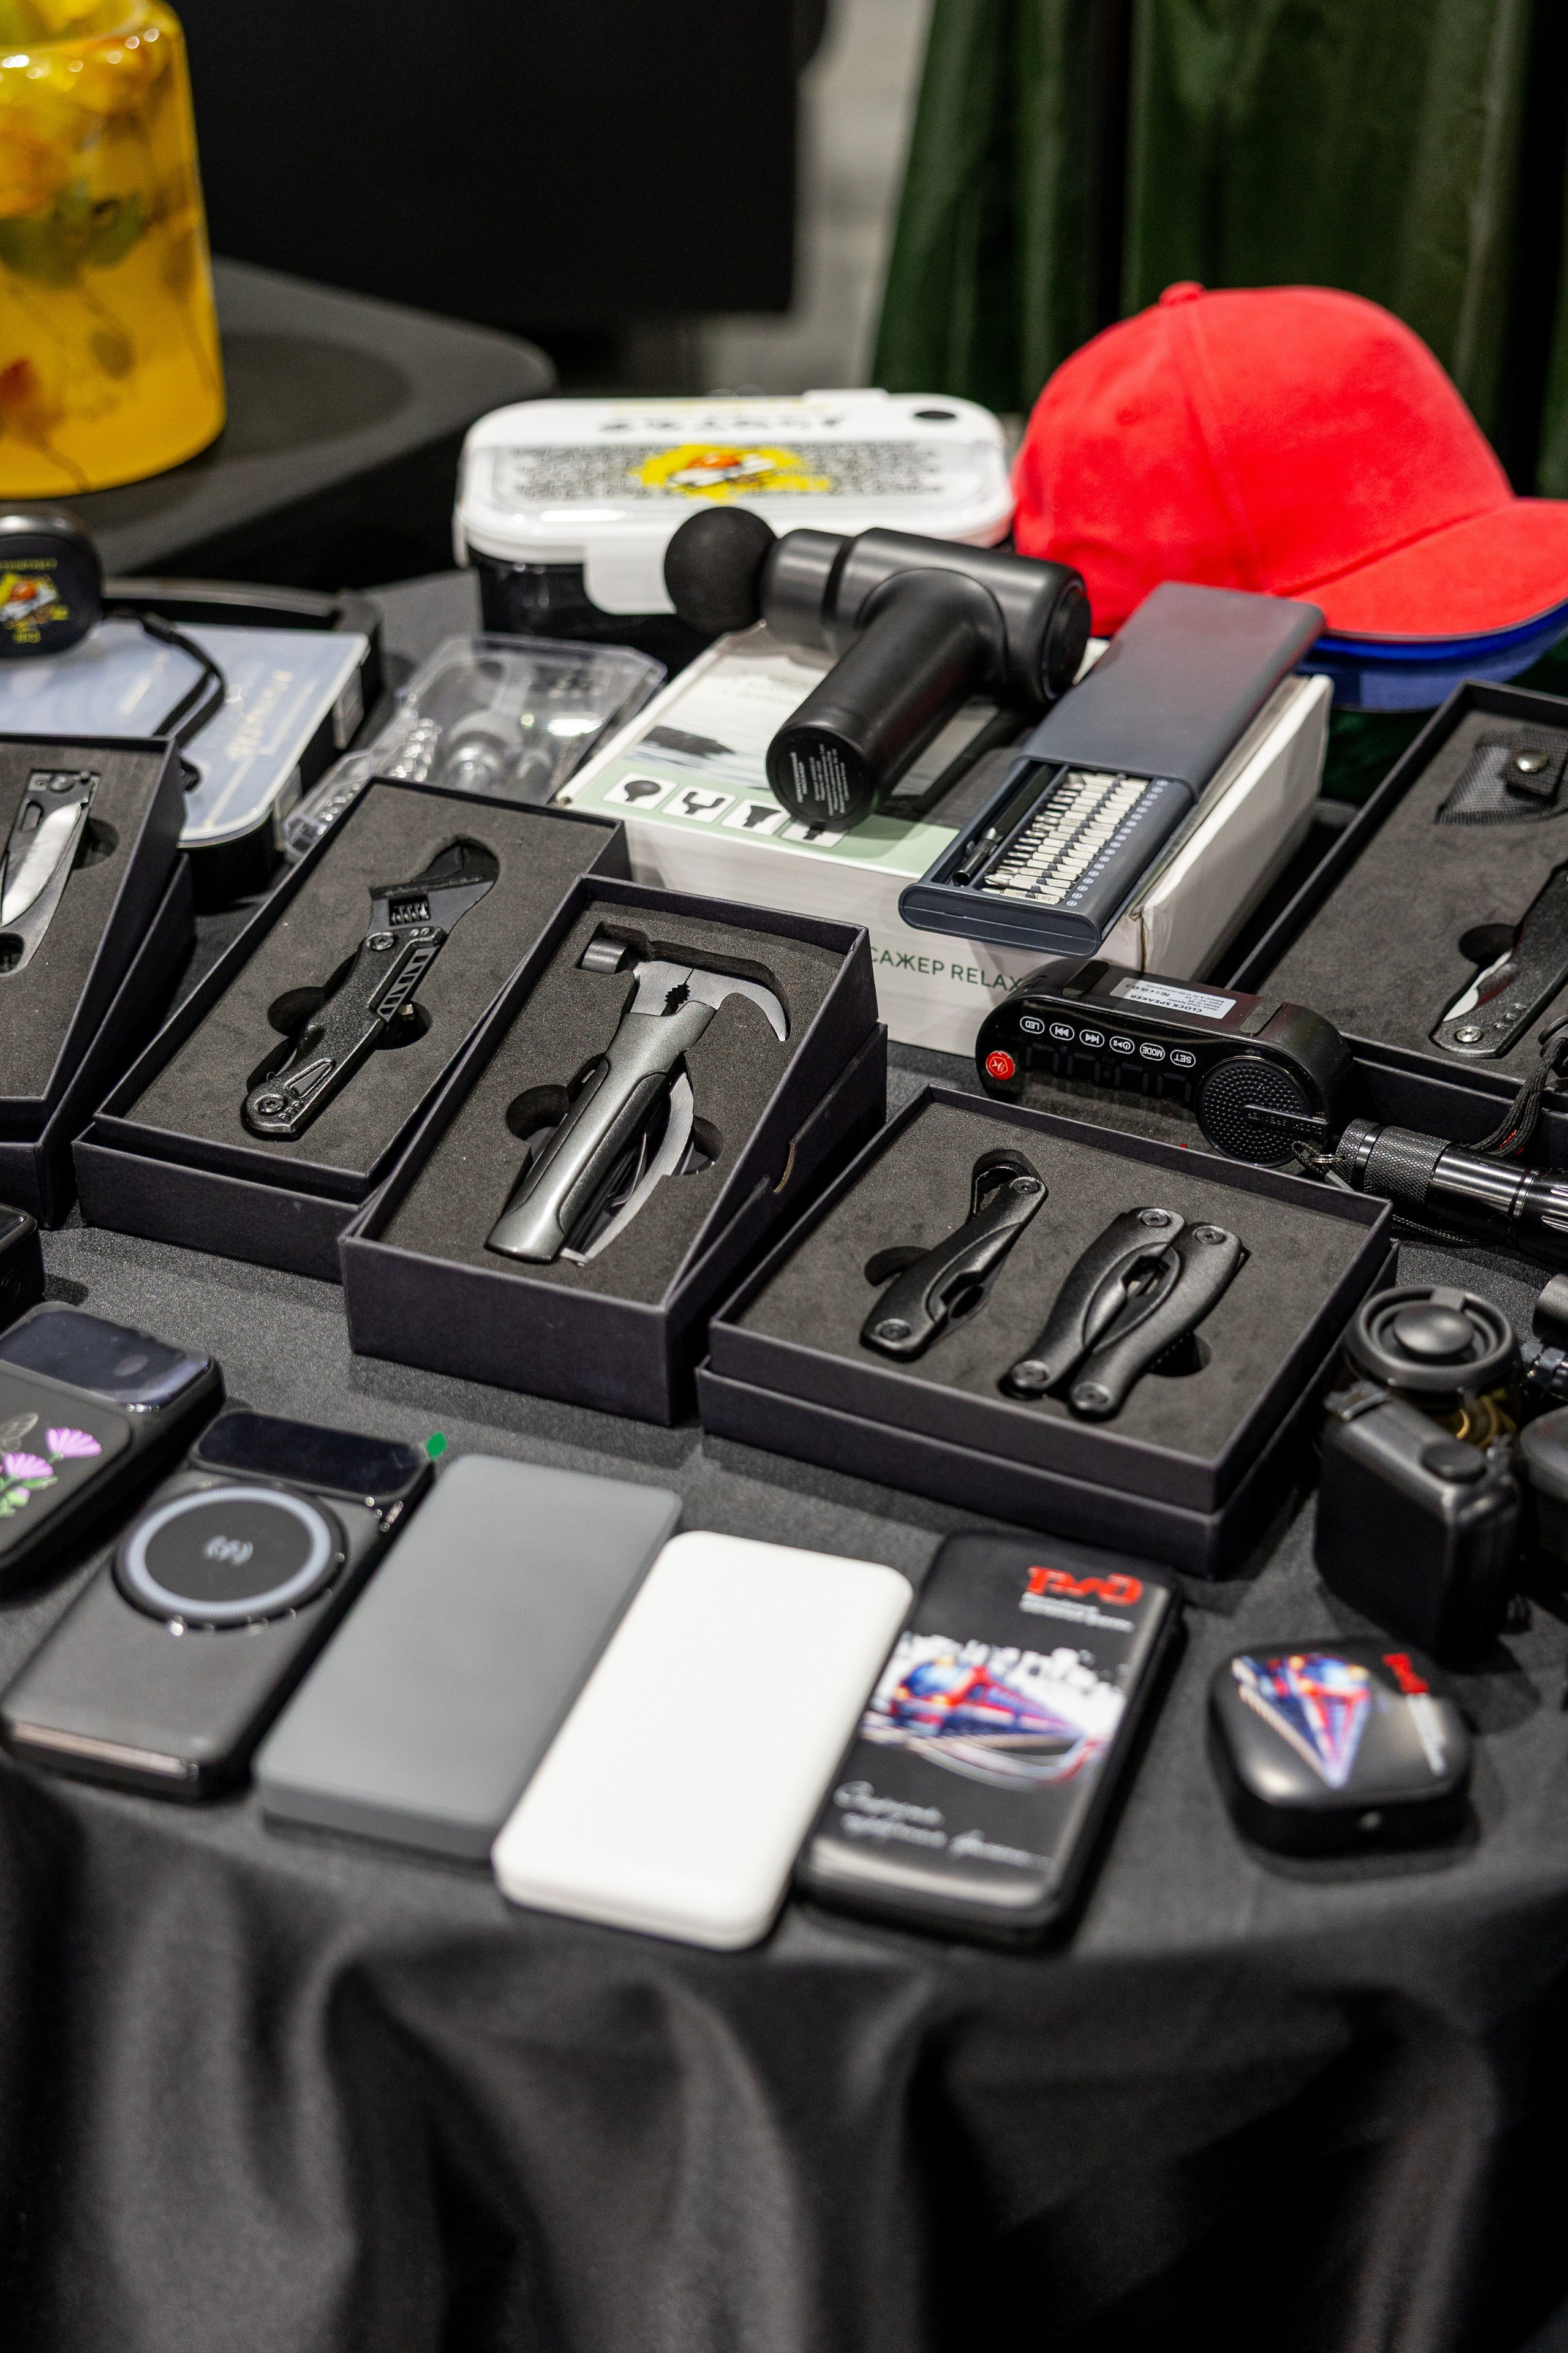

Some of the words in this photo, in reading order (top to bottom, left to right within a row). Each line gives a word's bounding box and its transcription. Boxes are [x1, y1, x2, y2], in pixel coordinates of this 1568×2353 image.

[951, 964, 1022, 992] RELAX
[1129, 994, 1171, 1005] SPEAKER
[1172, 1003, 1202, 1012] CLOCK
[1025, 1020, 1040, 1030] LED
[1142, 1046, 1163, 1057] MODE
[1174, 1054, 1192, 1063] SET
